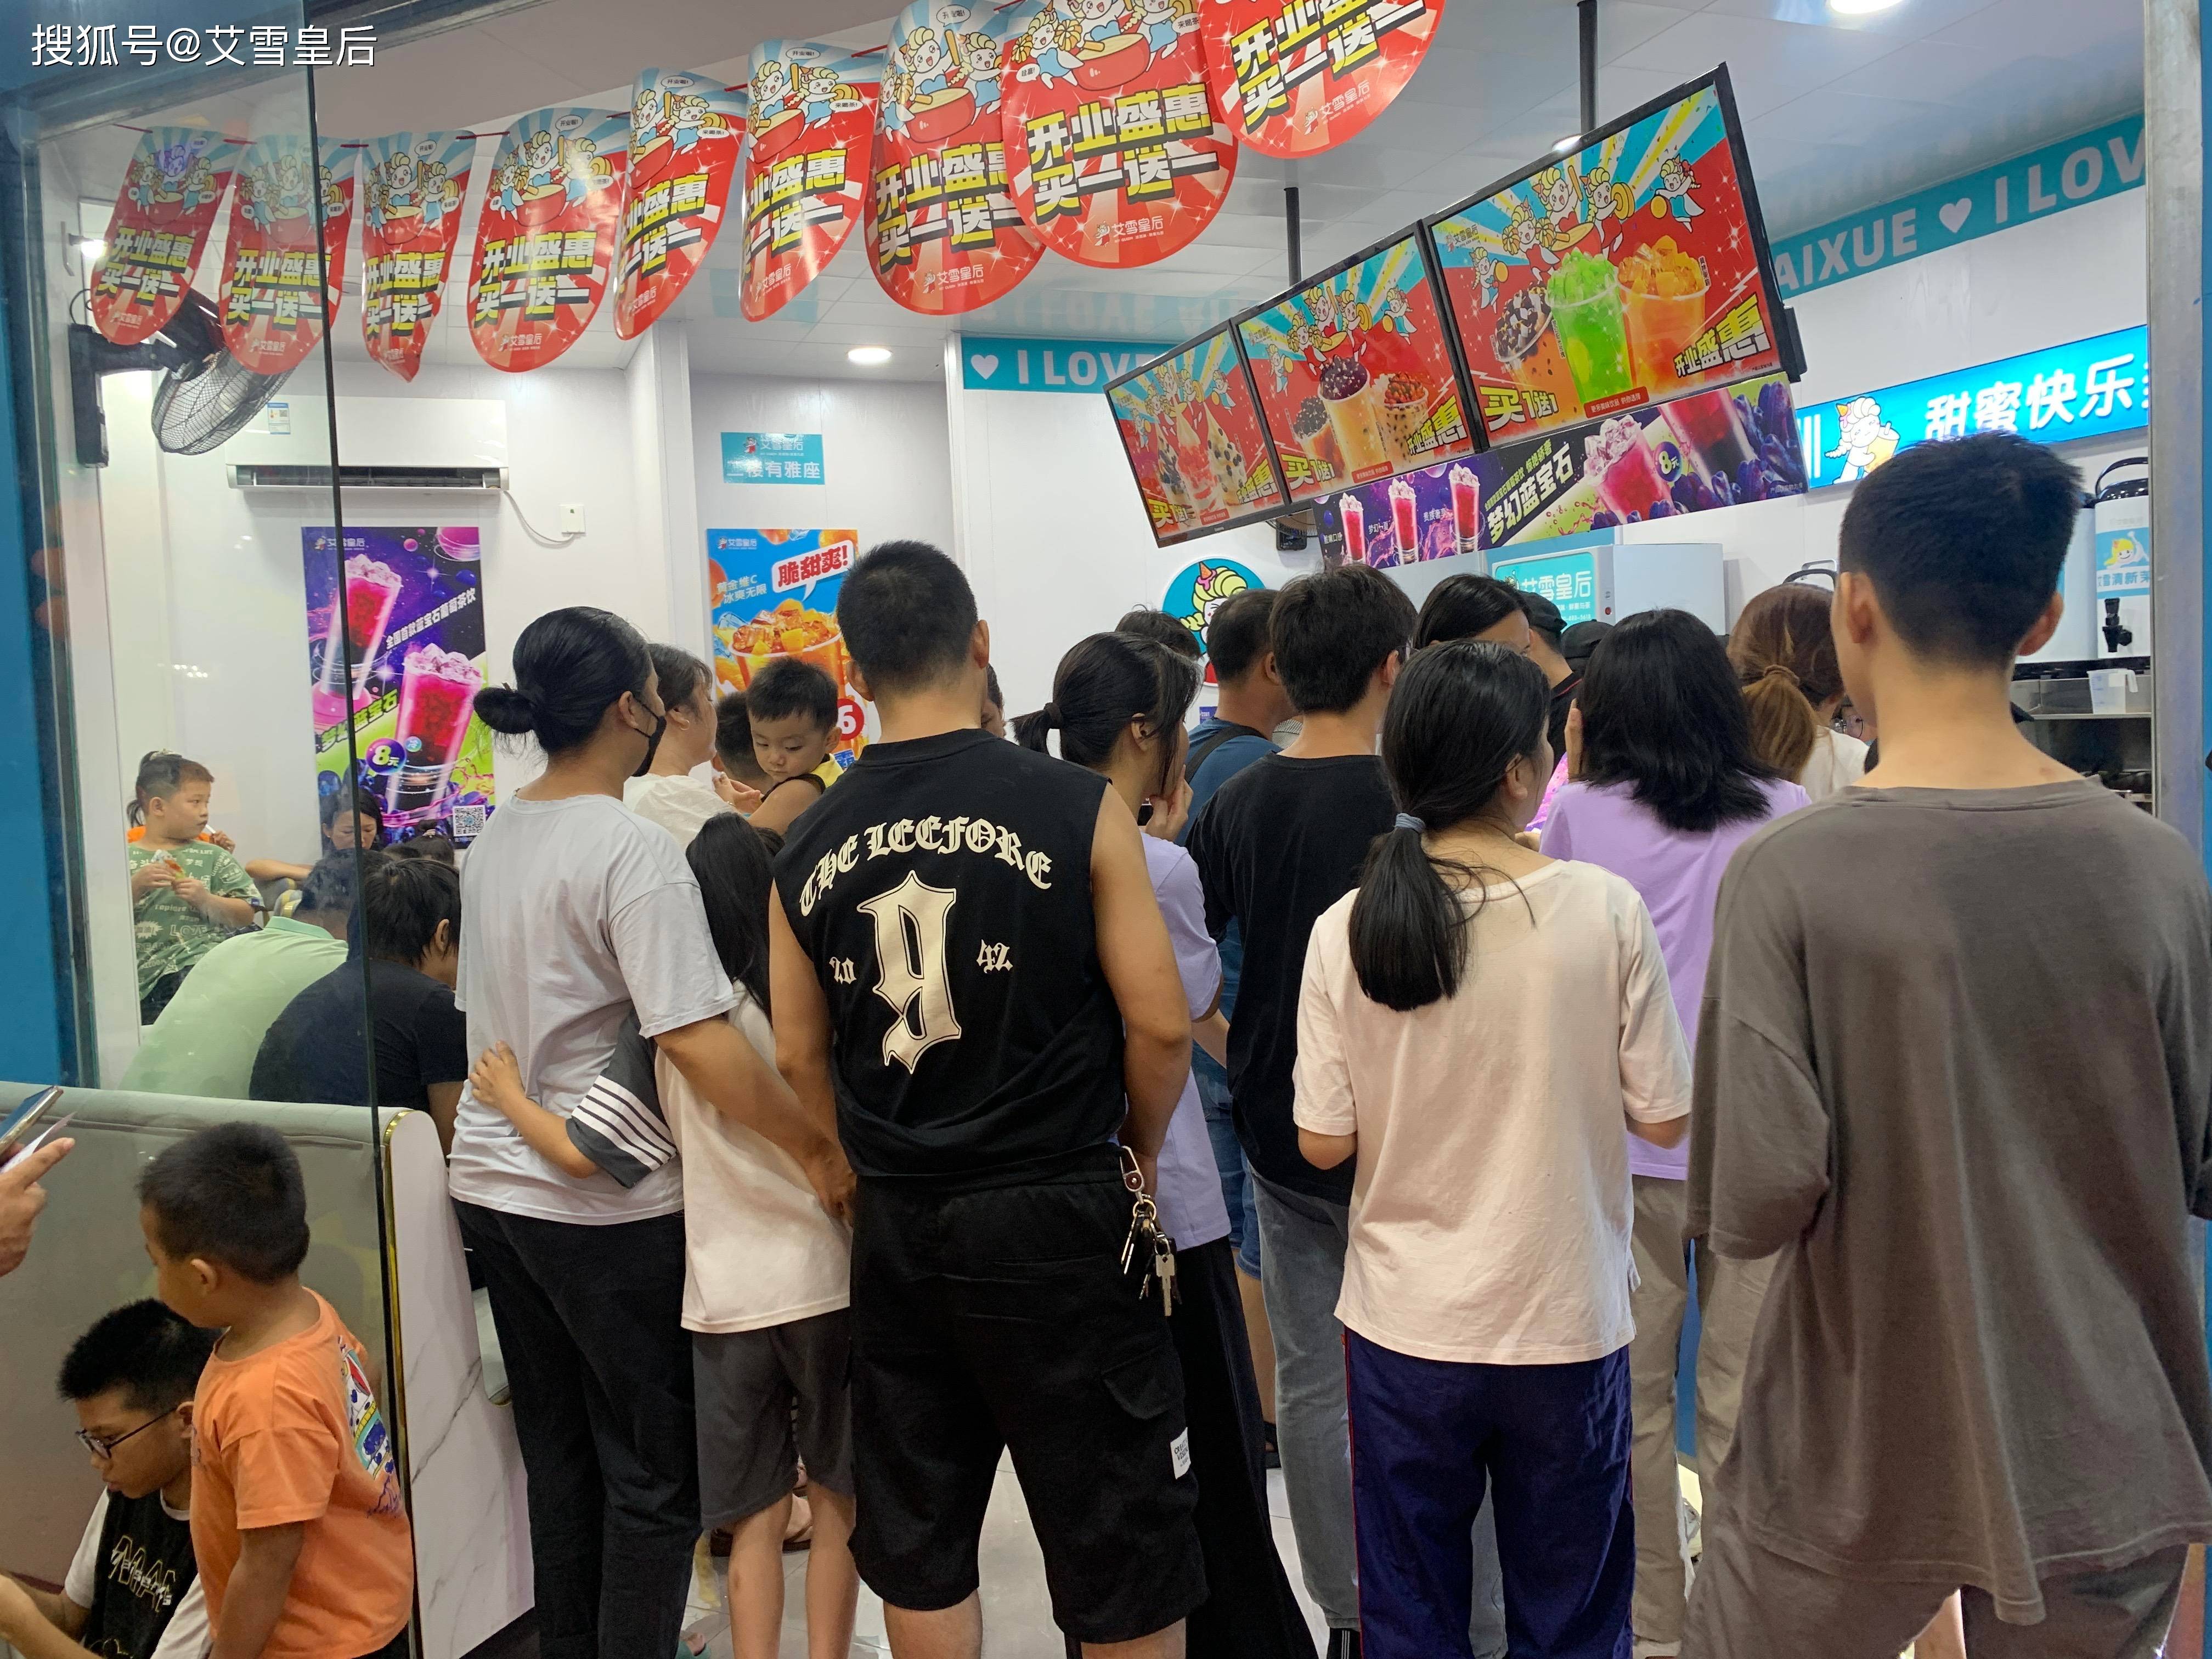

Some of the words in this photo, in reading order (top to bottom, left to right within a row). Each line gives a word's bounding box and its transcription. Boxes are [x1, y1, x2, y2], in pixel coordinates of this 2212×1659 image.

[1239, 0, 1426, 134] 买一送一
[1319, 80, 1370, 120] 艾雪皇后
[1026, 82, 1214, 171] 开业盛惠
[1031, 145, 1220, 225] 买一送一
[1995, 176, 2008, 224] I
[110, 226, 195, 273] 开业盛惠
[1111, 216, 1164, 238] 艾雪皇后
[233, 248, 332, 292] 开业盛惠
[366, 251, 446, 299] 开业盛惠
[482, 230, 597, 282] 开业盛惠
[937, 264, 984, 285] 艾雪皇后
[95, 262, 180, 306] 买一送一
[474, 275, 590, 328] 买一送一
[226, 287, 323, 331] 买一送一
[367, 295, 433, 341] 买一送一
[510, 334, 543, 346] 艾雪皇后
[1673, 292, 1771, 379] 开业盛惠
[1018, 349, 1029, 384] I
[1480, 386, 1558, 432] 买1送1
[1925, 353, 2149, 439] 甜蜜快乐
[1406, 394, 1468, 456] 开业盛惠
[1658, 450, 1680, 475] 8元
[1487, 443, 1574, 545] 梦幻蓝宝石
[778, 545, 848, 588] 脆甜爽!
[372, 745, 400, 766] 8元
[799, 834, 860, 917] THE
[864, 815, 1053, 890] LEEFORE
[857, 870, 962, 1075] 9
